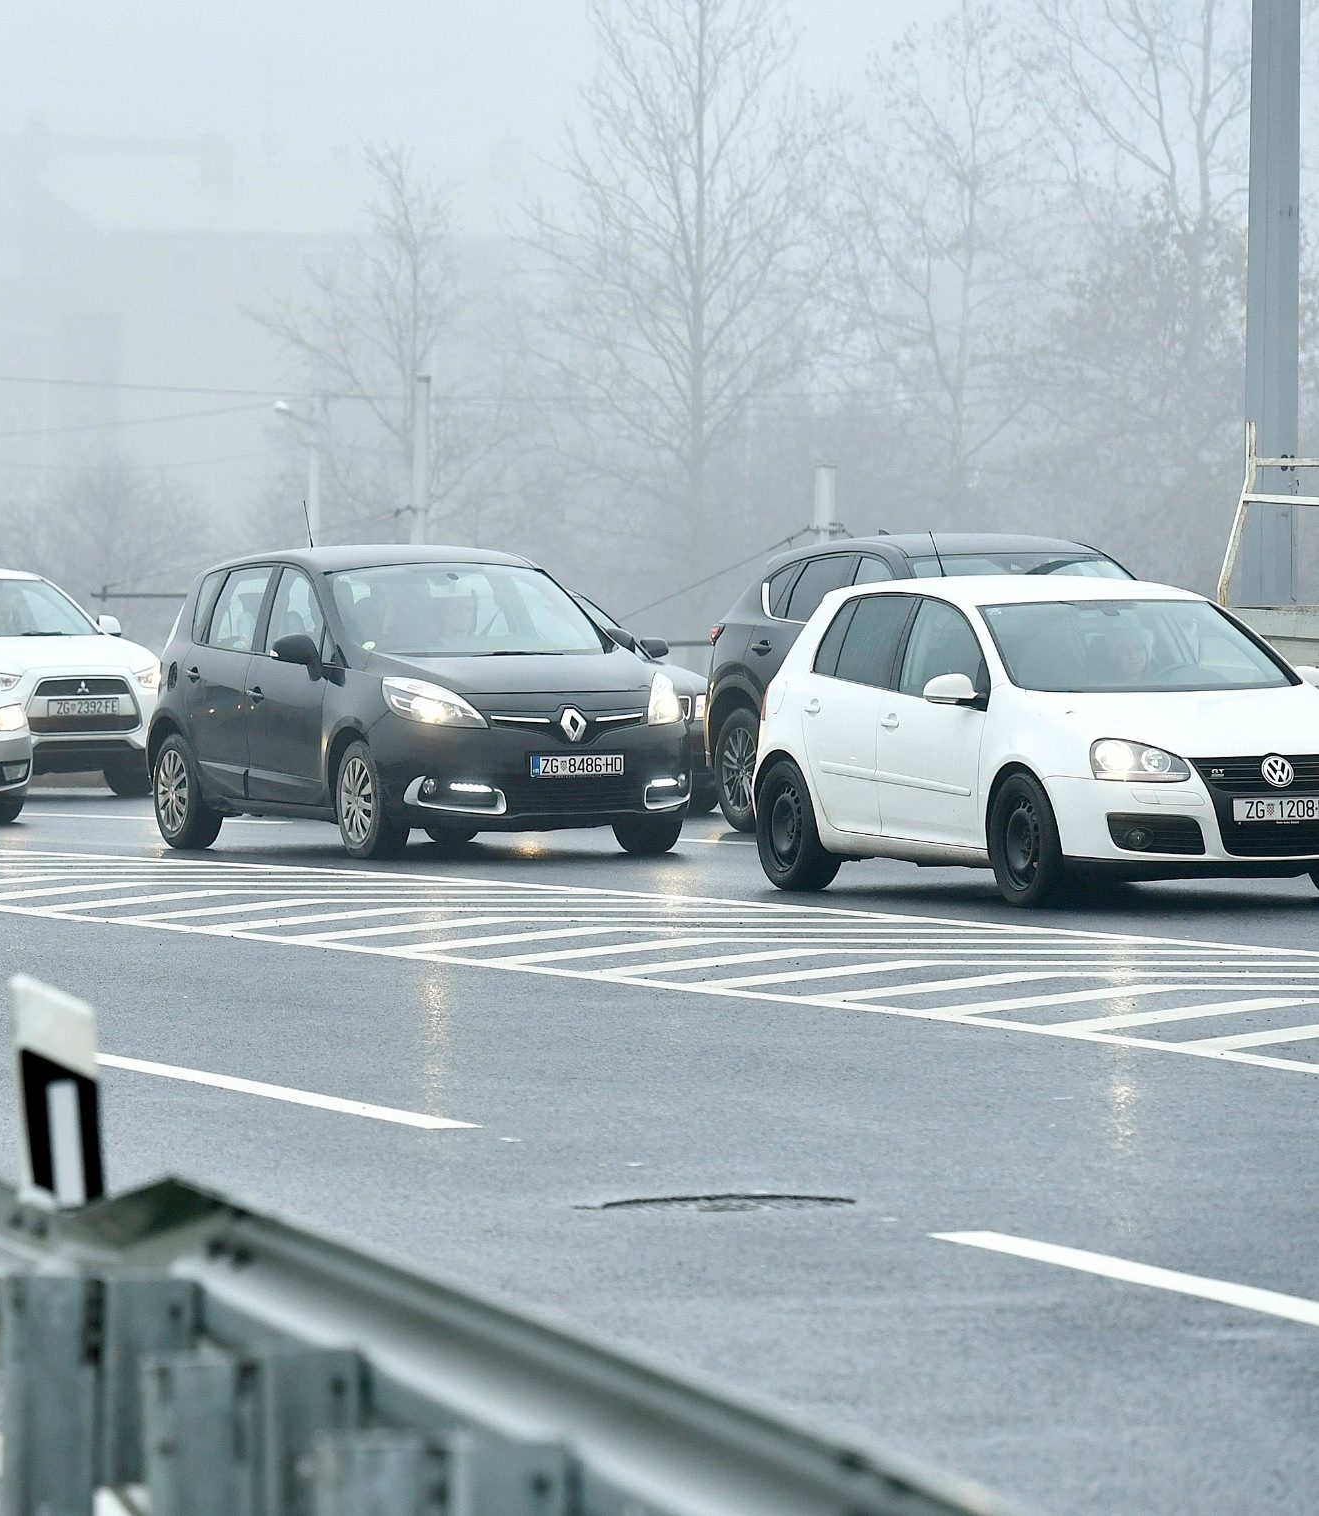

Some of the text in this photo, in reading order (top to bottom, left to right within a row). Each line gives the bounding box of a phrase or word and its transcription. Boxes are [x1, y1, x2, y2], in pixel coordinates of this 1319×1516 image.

[57, 701, 70, 714] ZG
[541, 758, 559, 774] ZG
[1244, 799, 1319, 819] ZG 1208-
